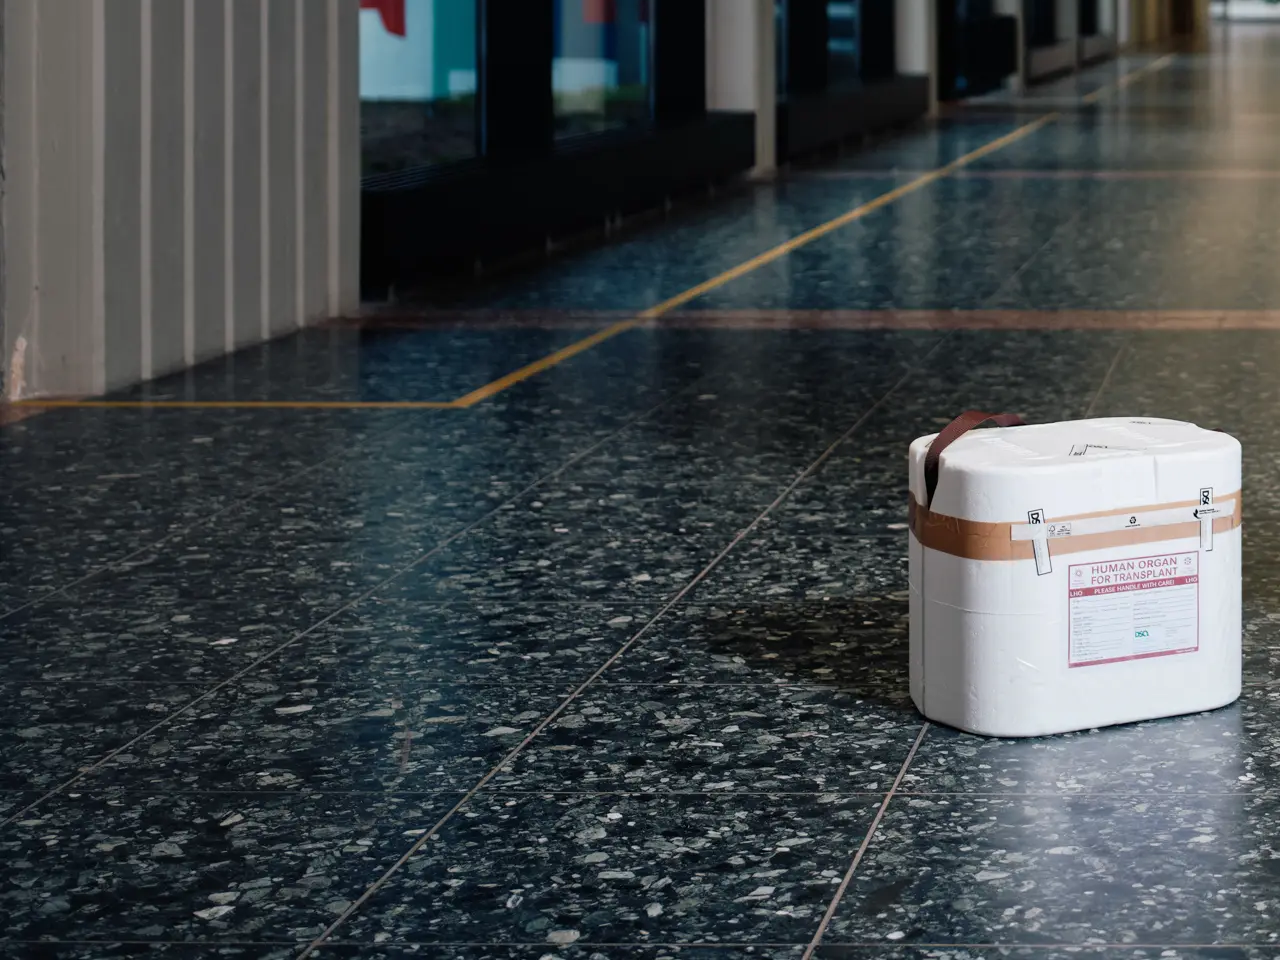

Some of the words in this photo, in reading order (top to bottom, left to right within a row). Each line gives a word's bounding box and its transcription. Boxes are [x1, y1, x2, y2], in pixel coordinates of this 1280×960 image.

[1091, 561, 1135, 574] HUMAN
[1138, 556, 1178, 569] ORGAN
[1091, 574, 1111, 585] FOR
[1113, 567, 1178, 582] TRANSPLANT
[1094, 586, 1116, 594] PLEASE
[1116, 583, 1140, 592] HANDLE
[1141, 580, 1157, 589] WITH
